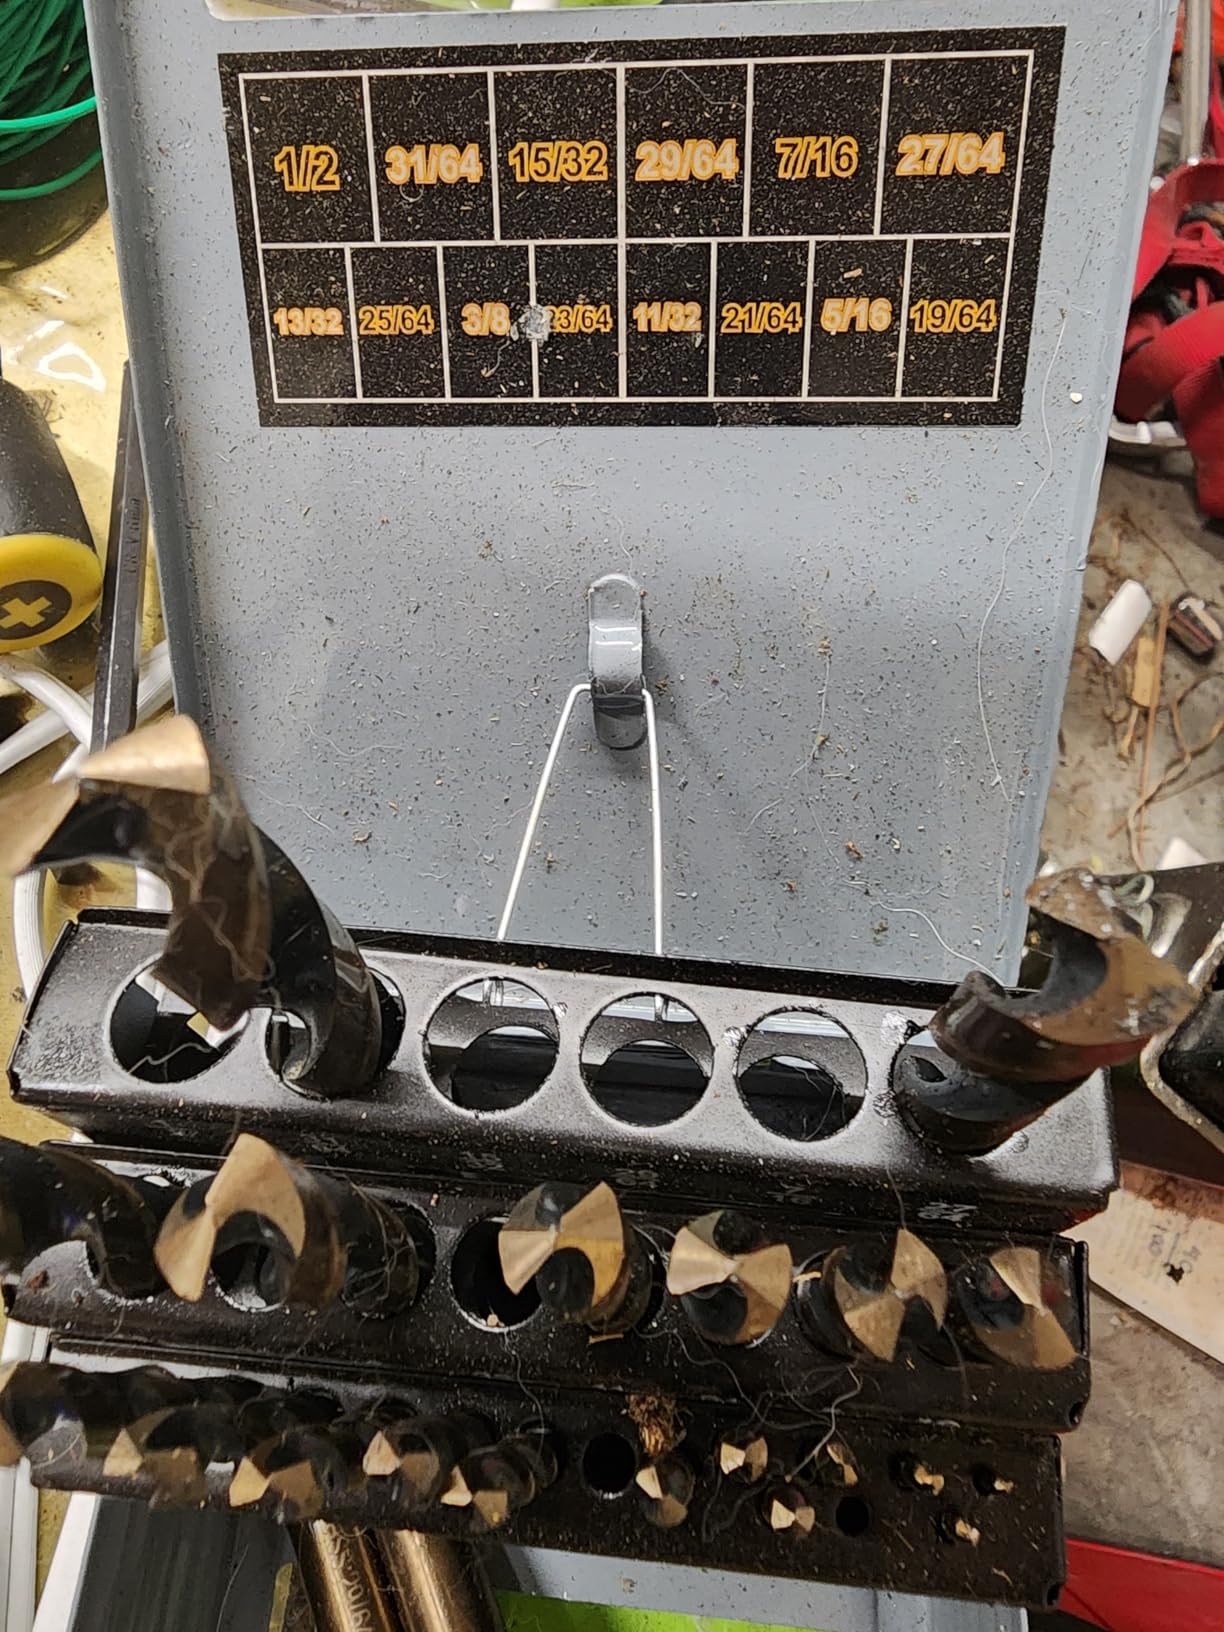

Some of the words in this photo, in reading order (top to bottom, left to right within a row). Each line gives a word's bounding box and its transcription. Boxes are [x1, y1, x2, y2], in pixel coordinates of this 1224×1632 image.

[274, 145, 340, 192] 1/2
[385, 144, 483, 184] 31/64
[509, 141, 608, 182] 15/32
[635, 139, 739, 181] 29/64
[774, 136, 858, 178] 7/16
[896, 132, 1005, 175] 27/64
[274, 308, 344, 336] 13/32
[359, 305, 434, 335] 25/64
[462, 302, 510, 335] 3/8
[633, 302, 701, 332] 11/32
[721, 302, 802, 333] 21/64
[821, 298, 892, 332] 5/16
[910, 299, 997, 332] 19/64
